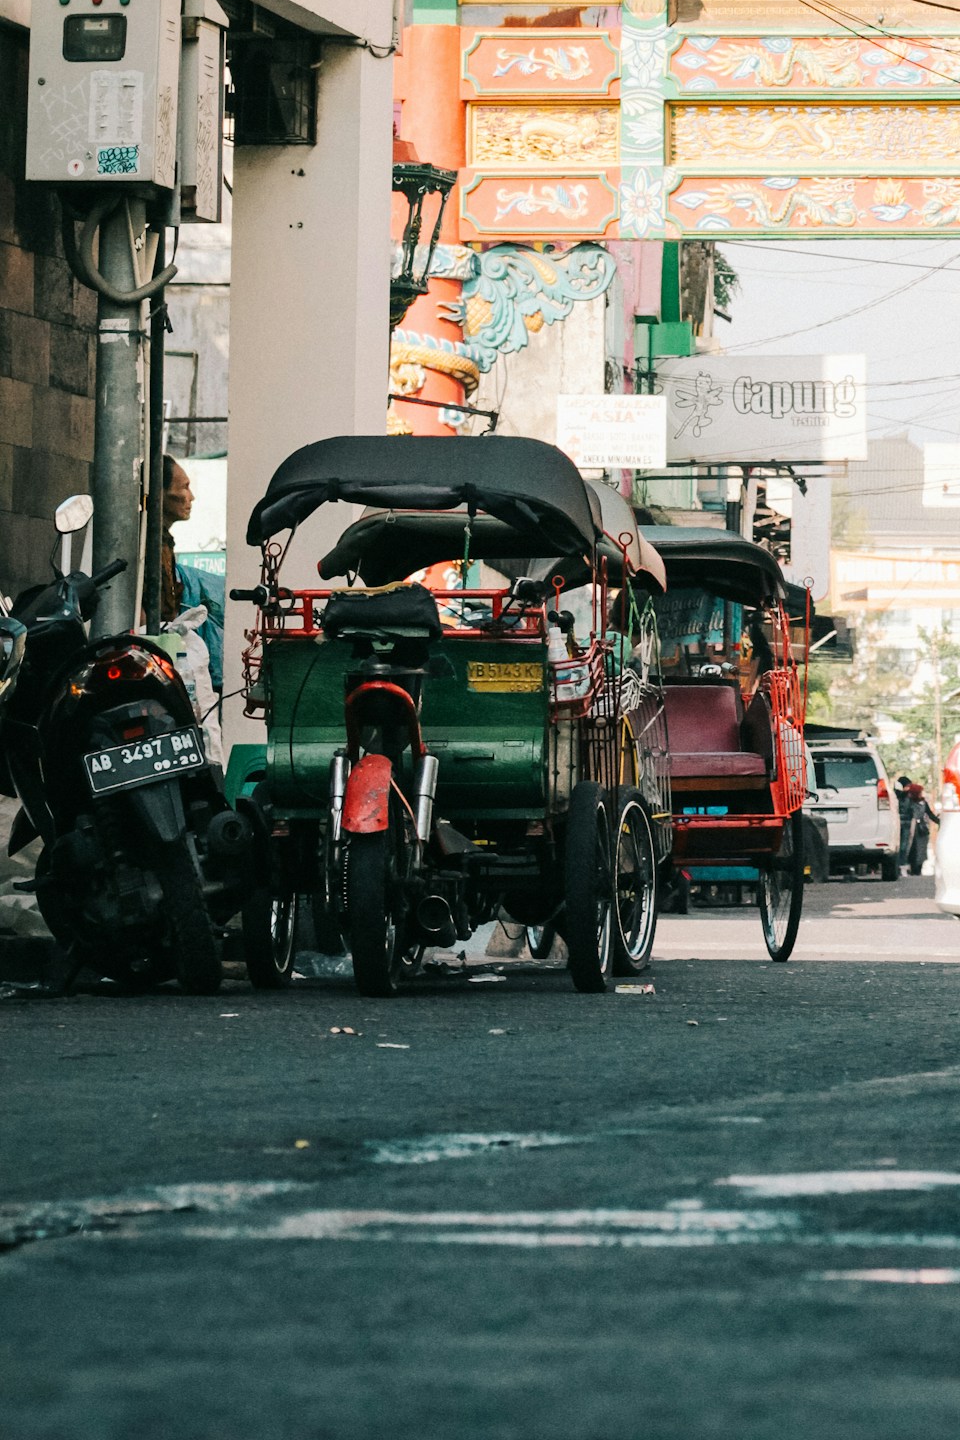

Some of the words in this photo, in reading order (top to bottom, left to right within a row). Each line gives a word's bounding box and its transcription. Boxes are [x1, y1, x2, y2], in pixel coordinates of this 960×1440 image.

[732, 374, 857, 419] Capung
[582, 454, 605, 464] ANEKA
[91, 754, 113, 773] AB
[120, 739, 162, 764] 3497
[154, 754, 198, 771] 09-20
